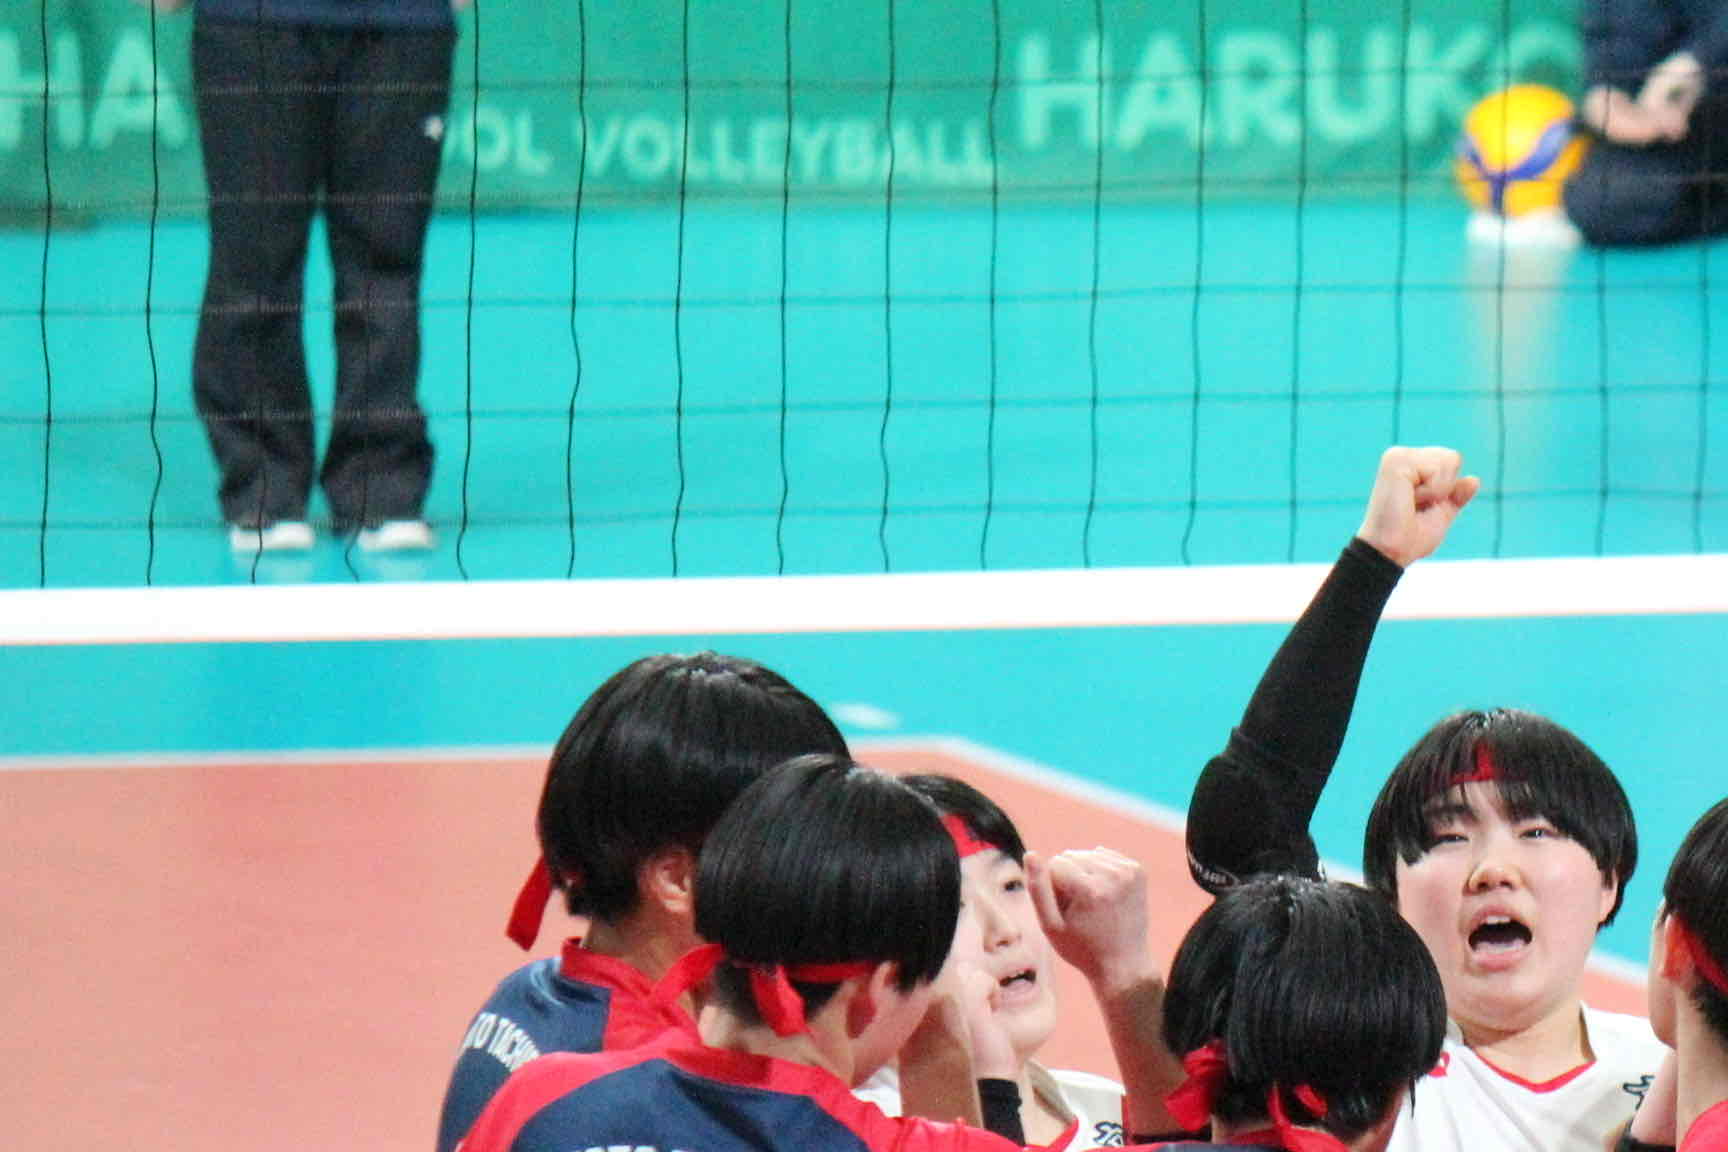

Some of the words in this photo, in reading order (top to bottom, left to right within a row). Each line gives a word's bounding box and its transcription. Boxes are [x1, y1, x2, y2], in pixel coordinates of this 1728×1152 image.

[0, 27, 192, 150] HA
[447, 108, 551, 178] OL
[573, 112, 997, 183] VOLLEYBALL
